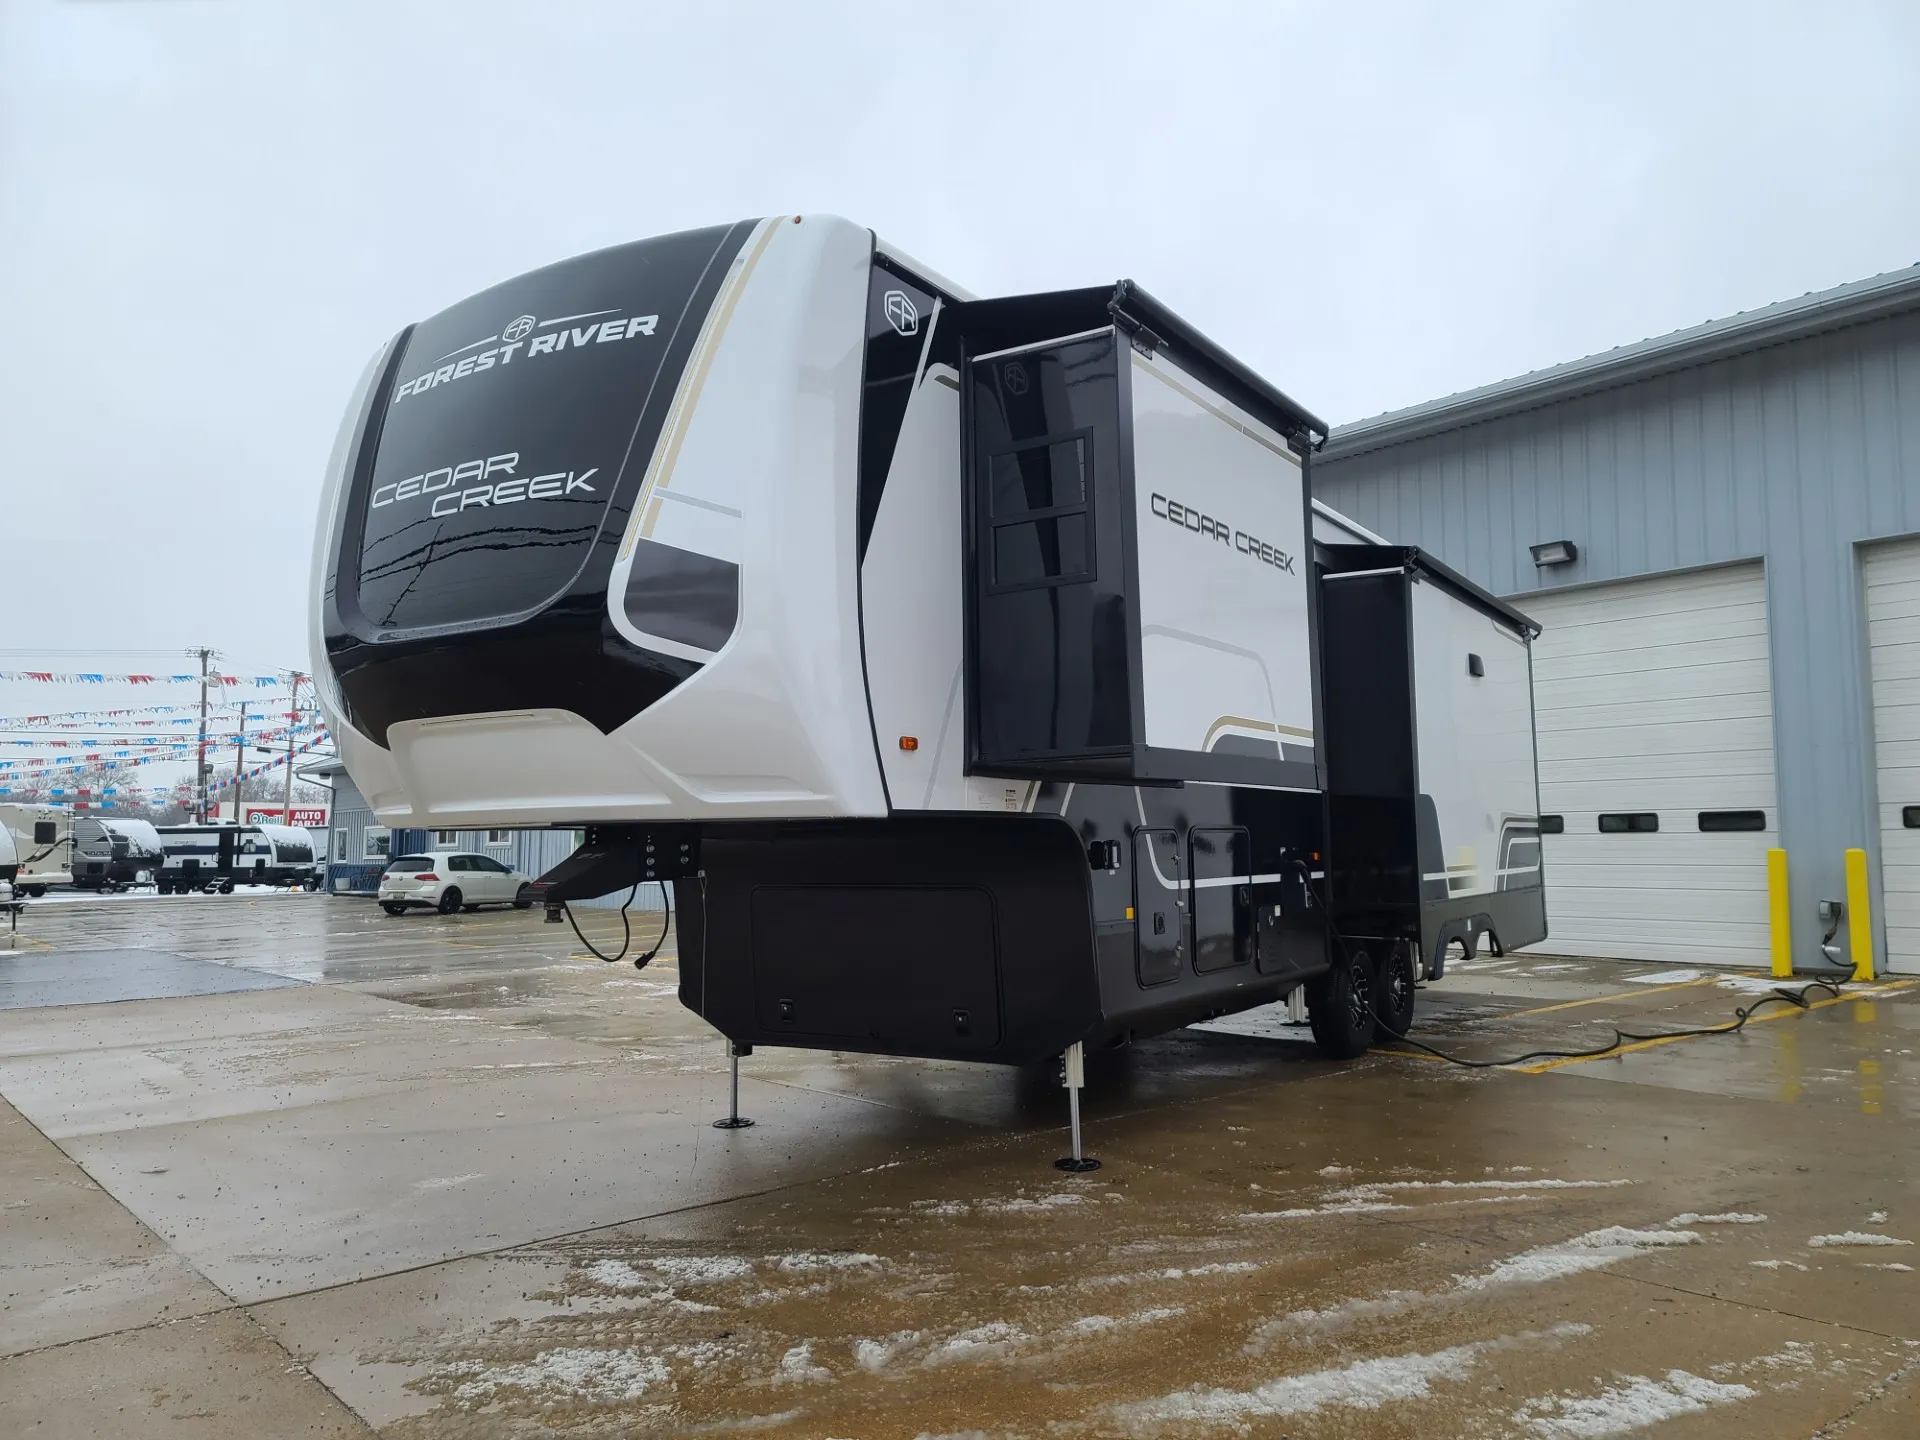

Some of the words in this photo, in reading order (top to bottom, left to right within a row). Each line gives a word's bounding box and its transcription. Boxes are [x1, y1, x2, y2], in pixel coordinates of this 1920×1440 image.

[395, 342, 523, 404] FOREST
[527, 314, 659, 358] RIVER
[371, 452, 519, 509] CEDAR
[431, 468, 599, 518] CREEK
[1151, 492, 1230, 547] CEDAR
[1235, 531, 1296, 577] CREEK
[250, 812, 284, 825] O'Reill
[294, 811, 321, 820] AUTO
